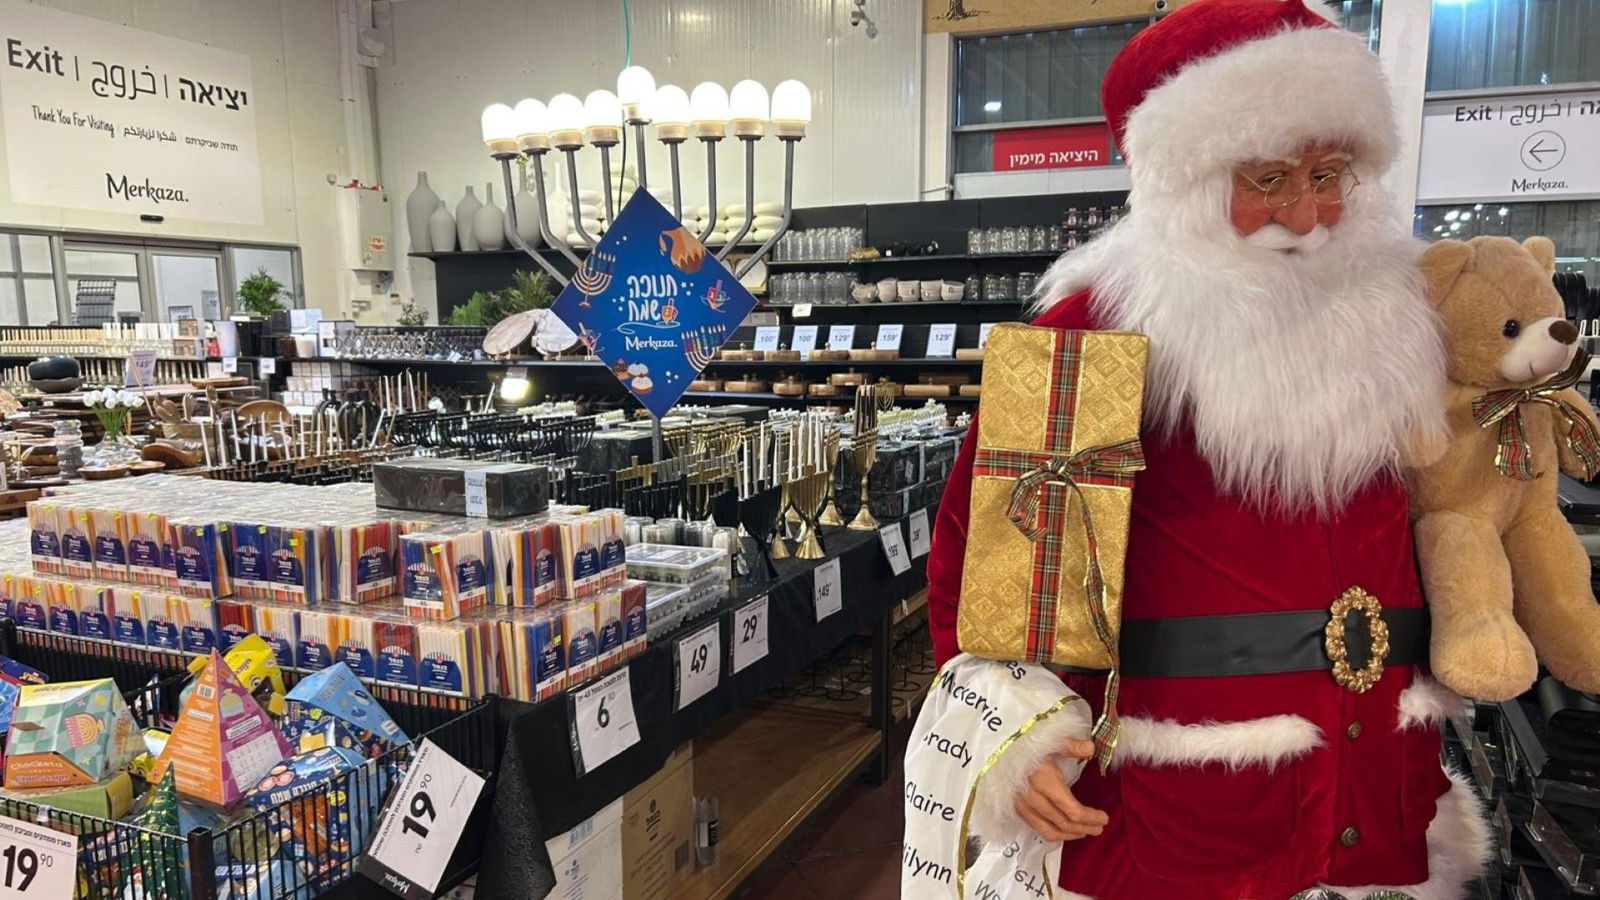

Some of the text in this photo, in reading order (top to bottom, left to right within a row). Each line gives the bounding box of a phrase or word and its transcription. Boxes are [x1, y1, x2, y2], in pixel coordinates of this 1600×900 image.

[7, 38, 65, 76] Exit
[91, 61, 157, 99] خروج
[178, 77, 248, 110] יציאה
[32, 105, 115, 138] Thank You For Visiting
[1455, 105, 1492, 122] Exit
[1510, 99, 1561, 126] خروج
[1009, 149, 1099, 168] היציאה מימין
[106, 172, 189, 204] Merkaza.
[1511, 178, 1568, 193] Merkaza.
[627, 274, 679, 298] חנוכה
[628, 299, 661, 322] שמח
[626, 335, 678, 351] Merkaza.
[742, 614, 757, 643] 29
[690, 644, 708, 674] 49
[1005, 660, 1027, 680] es
[597, 696, 610, 728] 6
[923, 732, 973, 768] rady
[420, 773, 432, 789] 90
[402, 791, 437, 839] 19
[906, 781, 955, 821] Claire
[3, 844, 38, 892] 19
[40, 853, 53, 867] 90
[904, 843, 952, 884] ilynn
